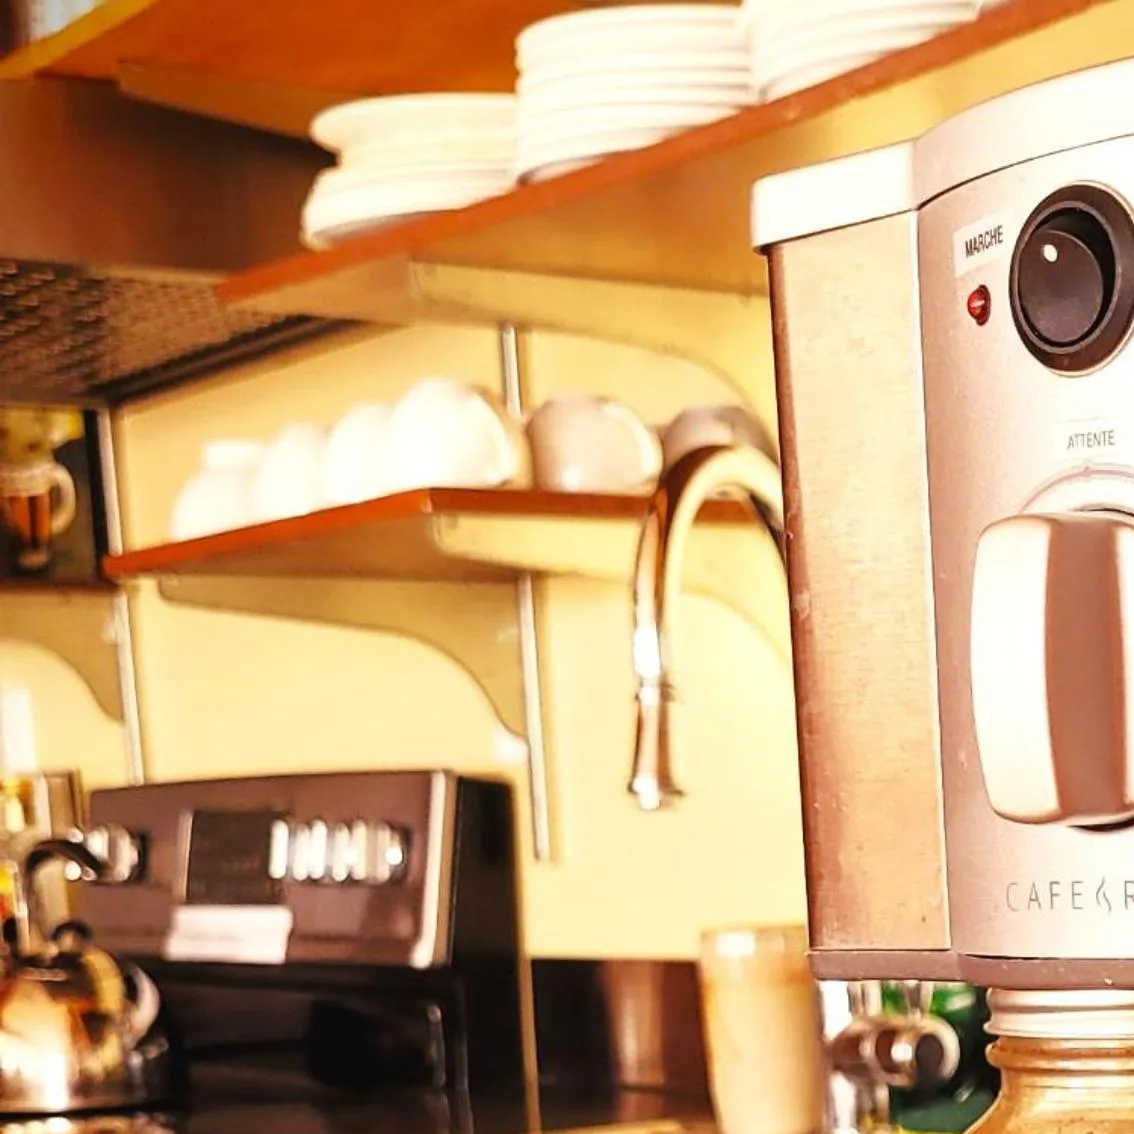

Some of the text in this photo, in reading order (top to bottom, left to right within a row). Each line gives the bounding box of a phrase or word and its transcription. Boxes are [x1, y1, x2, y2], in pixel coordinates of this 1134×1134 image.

[965, 225, 1004, 258] MARCHE
[1067, 429, 1115, 449] ATTENTE
[1006, 880, 1084, 911] CAFE
